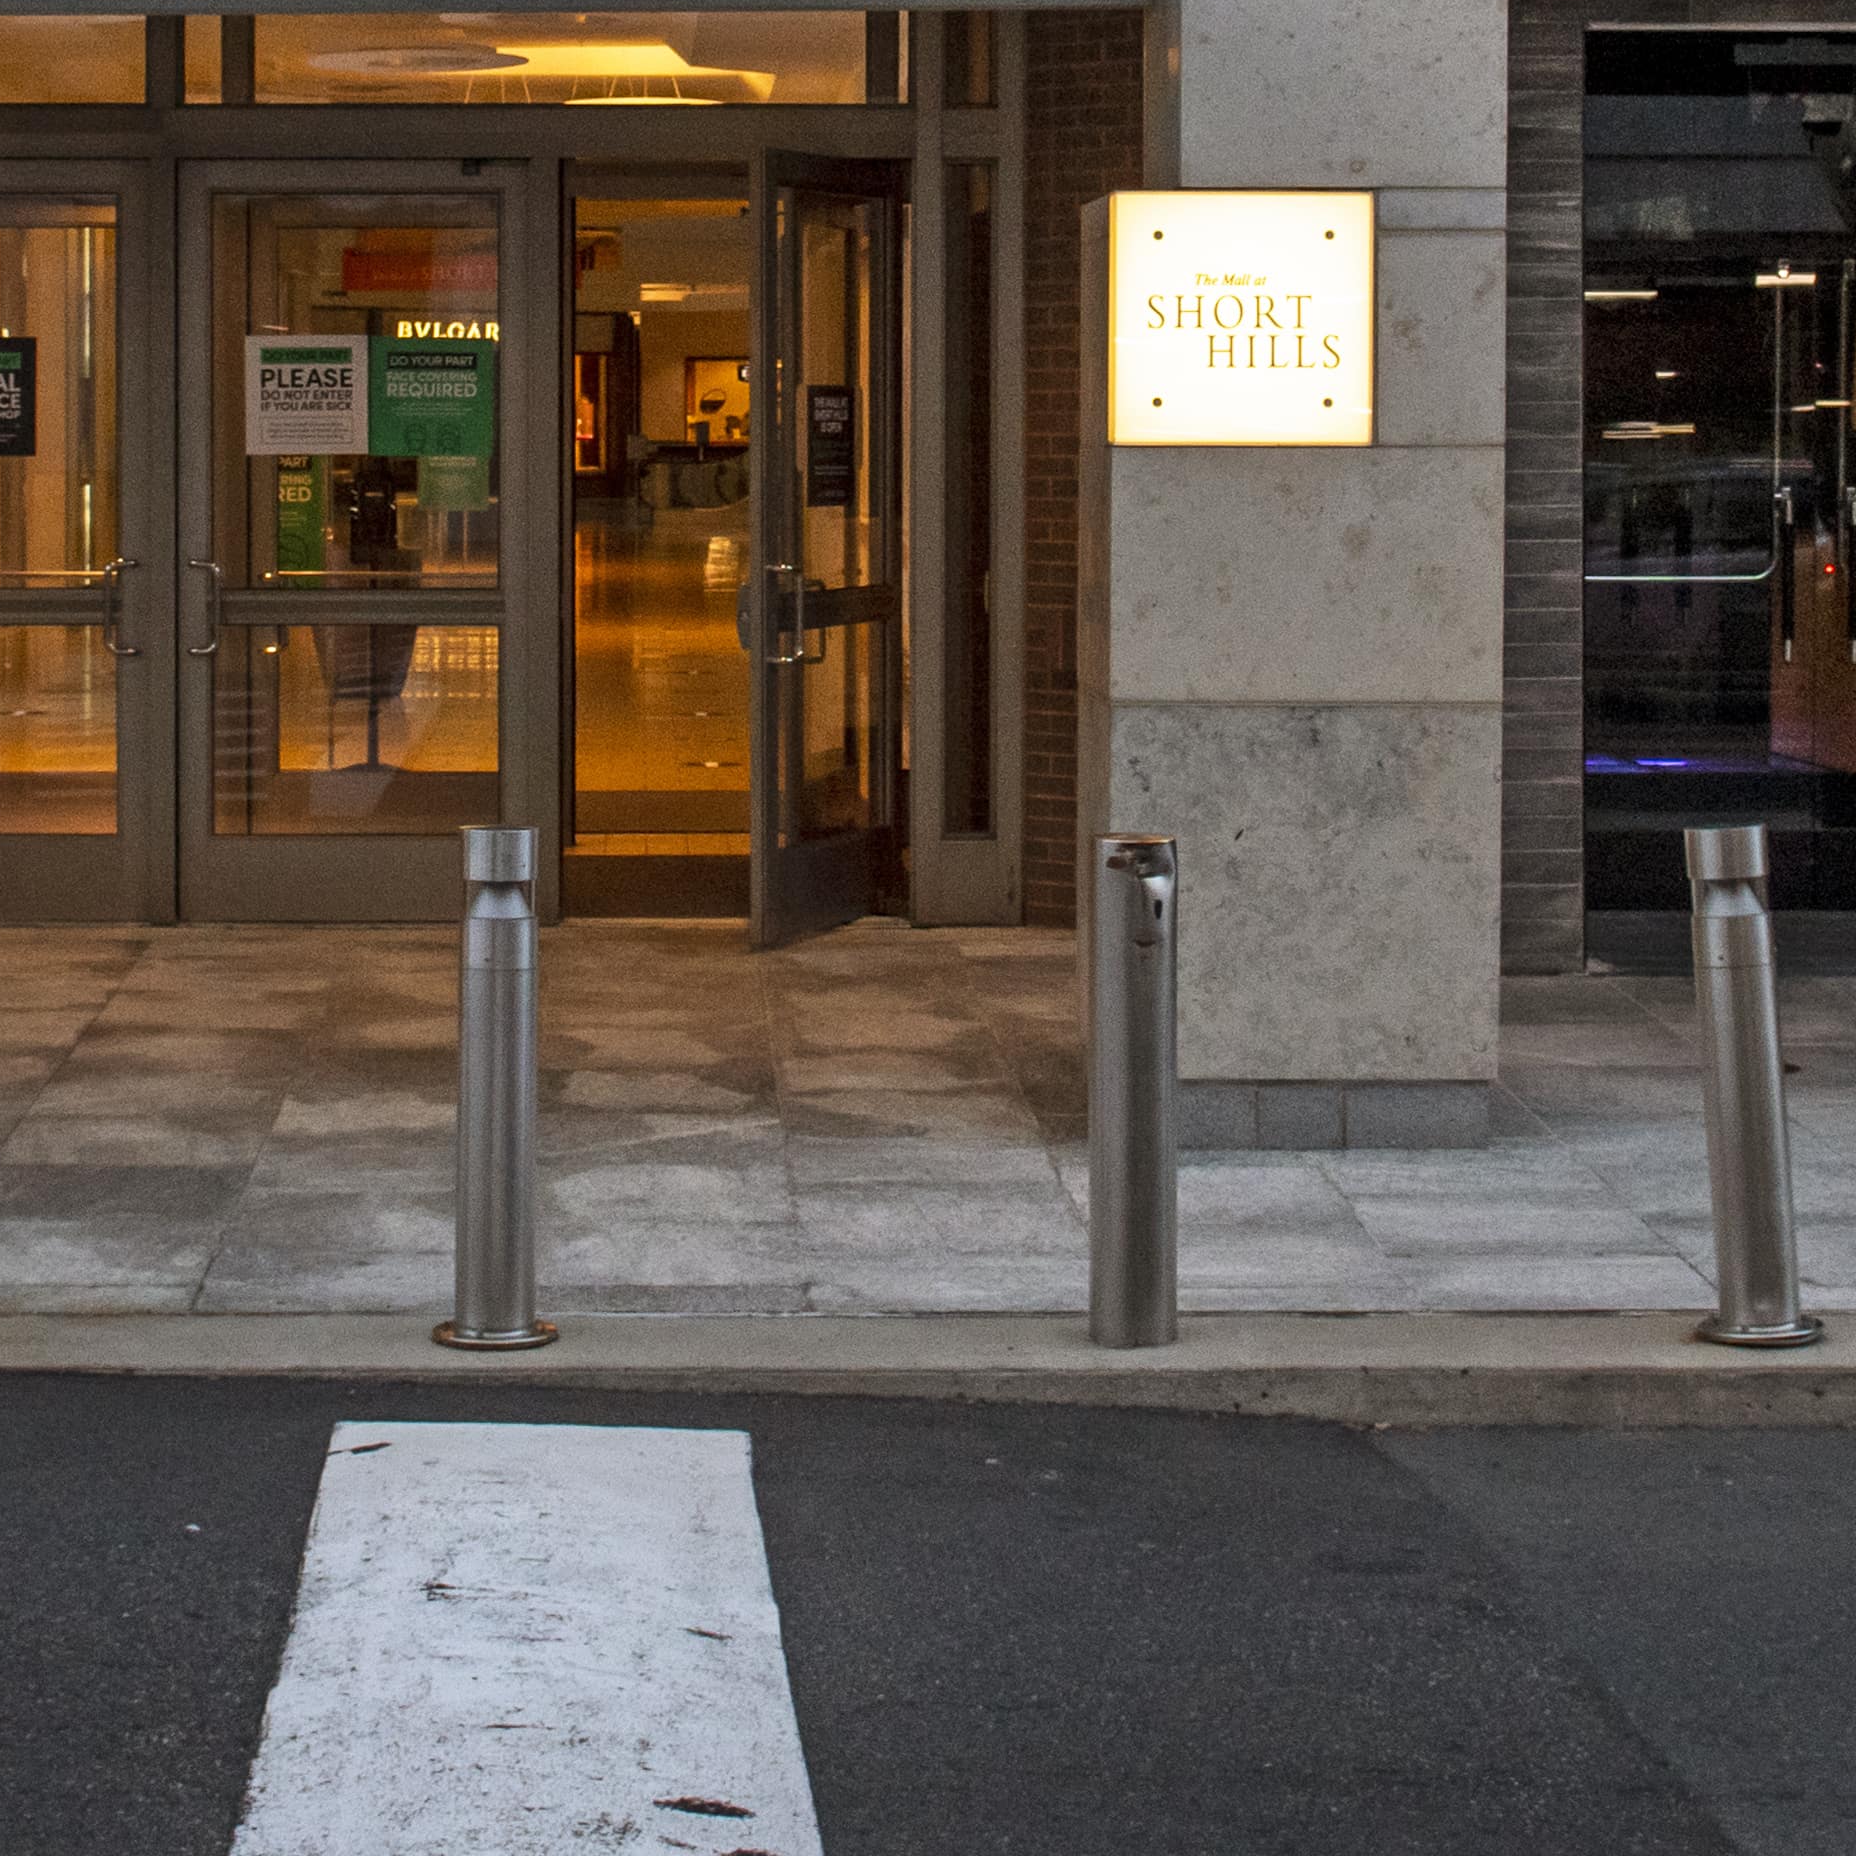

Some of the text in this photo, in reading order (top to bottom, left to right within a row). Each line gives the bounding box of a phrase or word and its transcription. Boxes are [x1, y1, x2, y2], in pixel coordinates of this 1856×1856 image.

[1195, 273, 1267, 286] The Mall at
[1147, 294, 1312, 329] SHORT
[1207, 334, 1341, 369] HILLS
[390, 355, 474, 366] DO YOUR PART
[260, 368, 353, 388] PLEASE
[386, 371, 477, 383] FACE COVERING
[260, 390, 353, 400] DO NOT ENTER
[386, 383, 478, 398] REQUIRED
[260, 402, 352, 412] IF YOU ARE SICK
